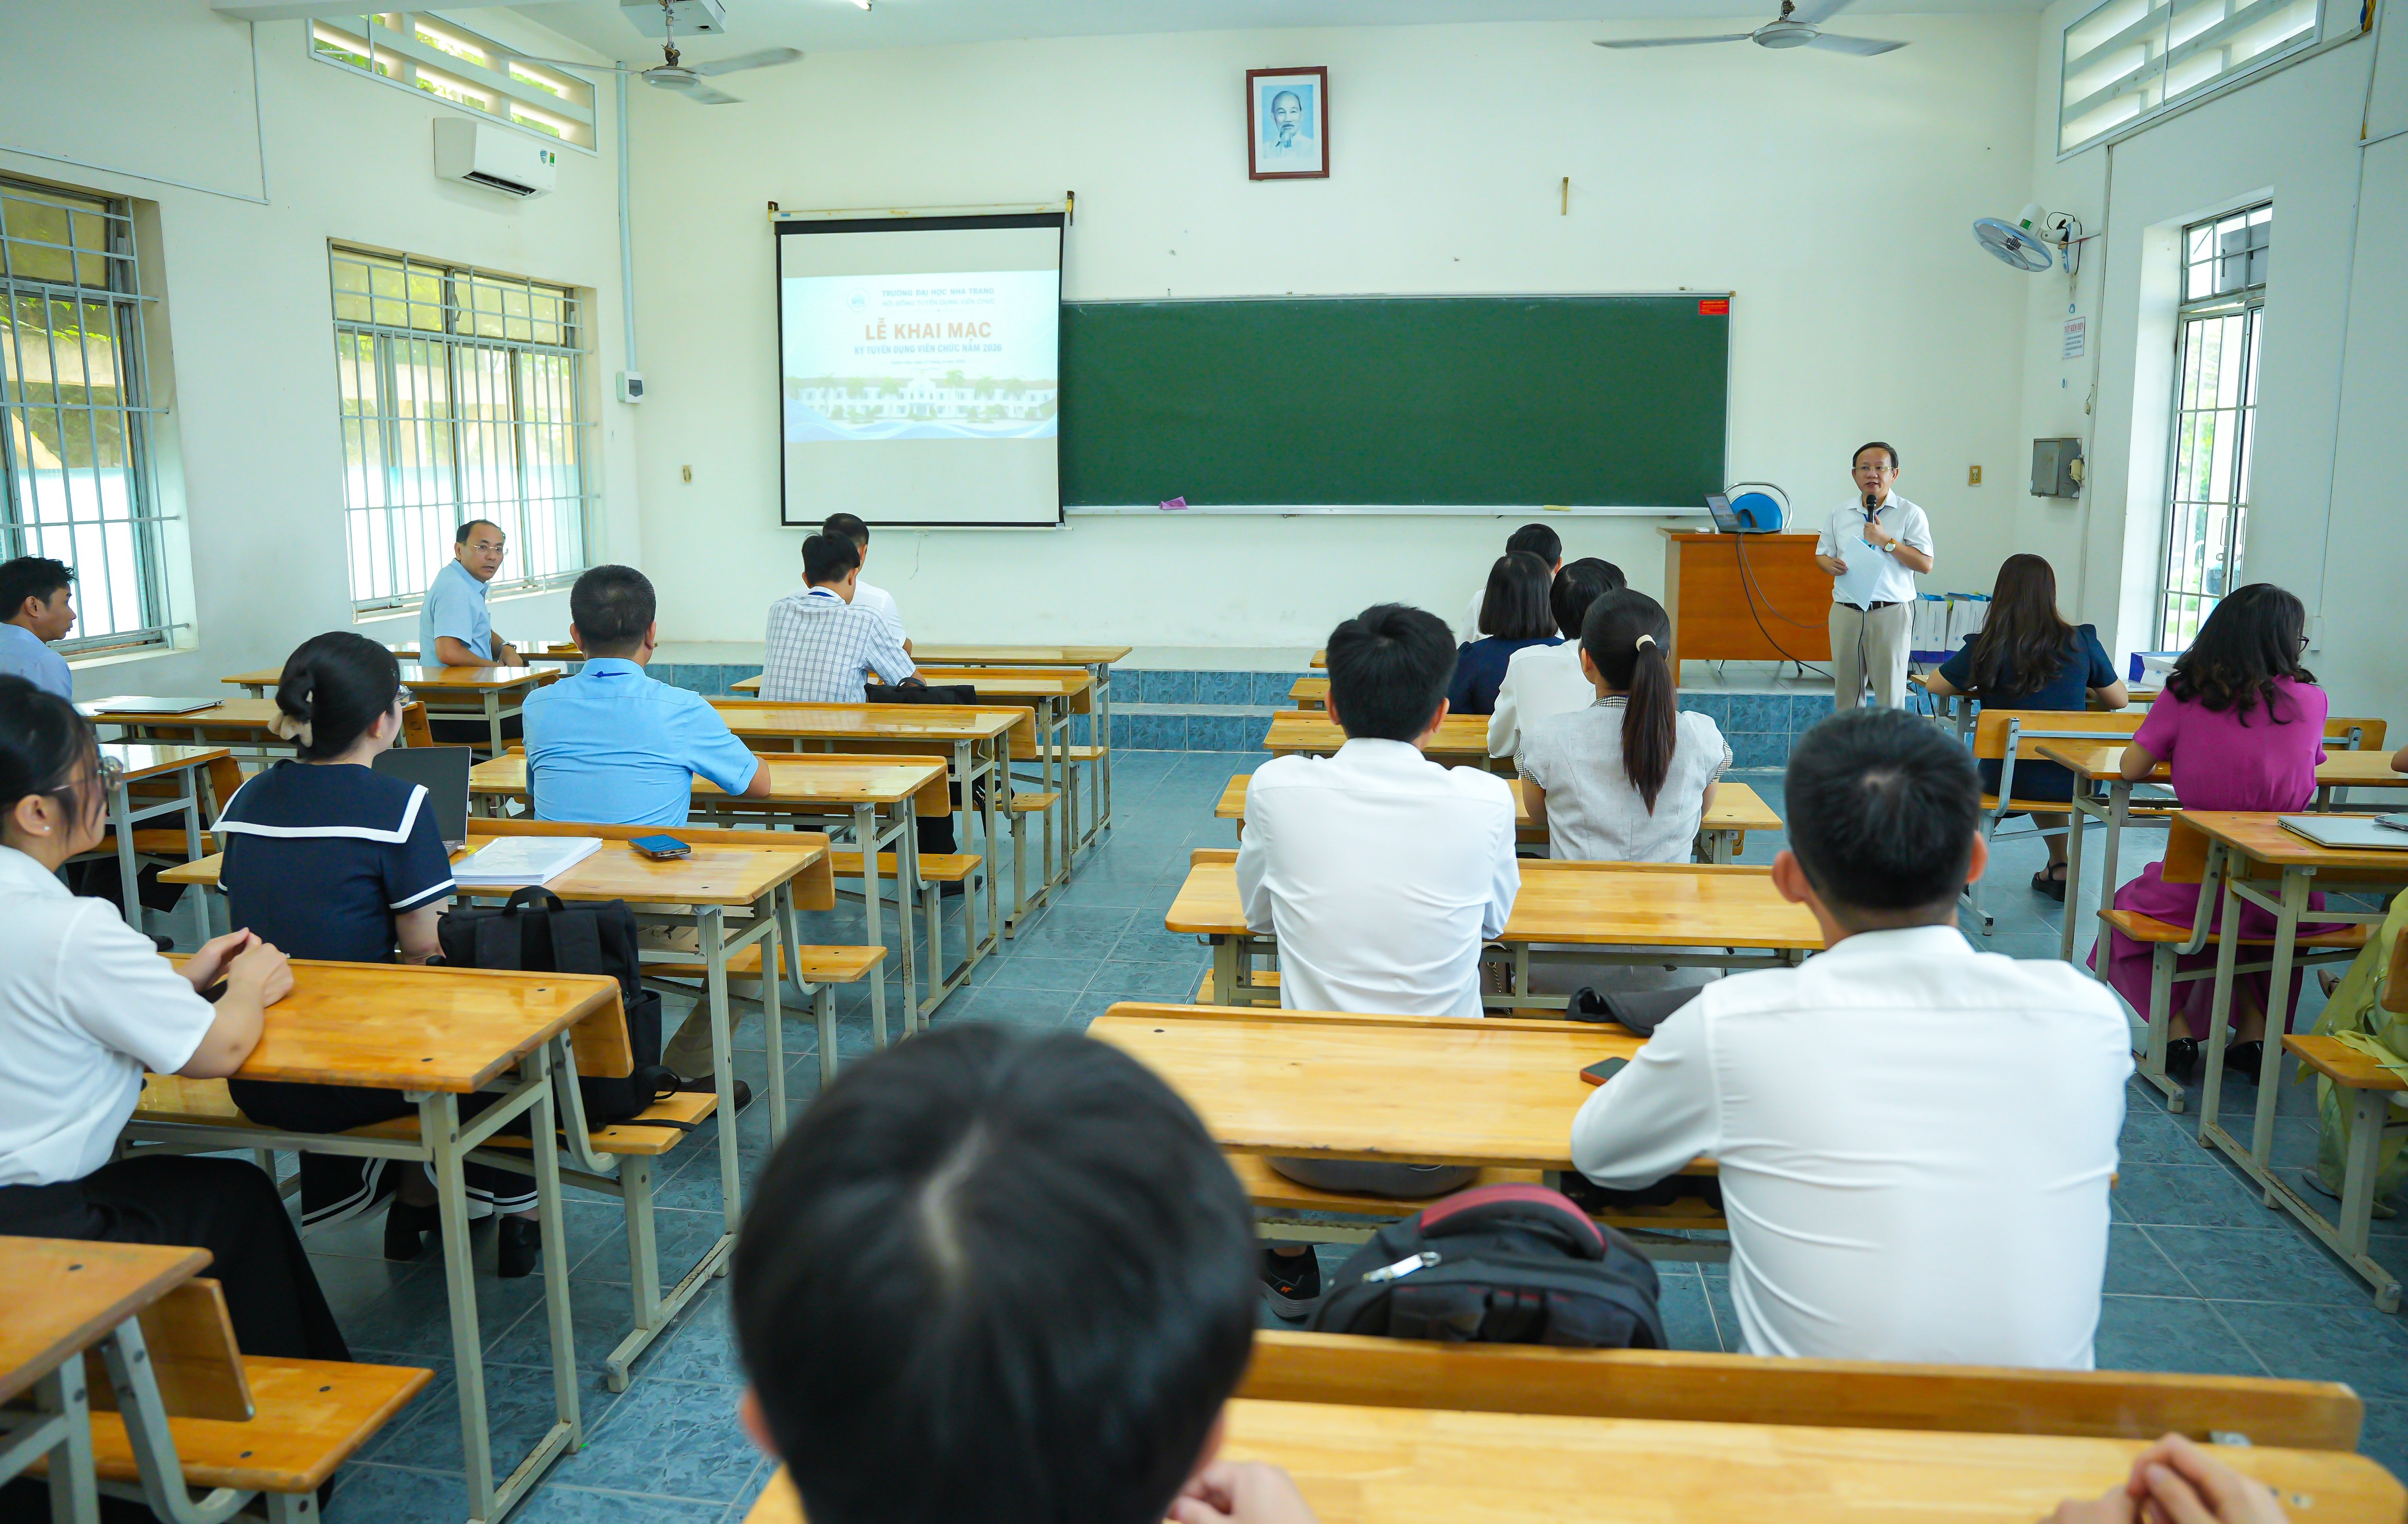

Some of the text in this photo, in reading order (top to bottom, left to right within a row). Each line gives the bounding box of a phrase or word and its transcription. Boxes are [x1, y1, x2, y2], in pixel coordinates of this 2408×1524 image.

[865, 317, 991, 341] LỄ KHAI MẠC
[867, 342, 891, 354] TUYỂN
[893, 344, 915, 355] DỤNG
[917, 343, 935, 353] VIÊN
[937, 342, 960, 352] CHỨC
[962, 342, 980, 352] NĂM
[982, 343, 1002, 352] 2026
